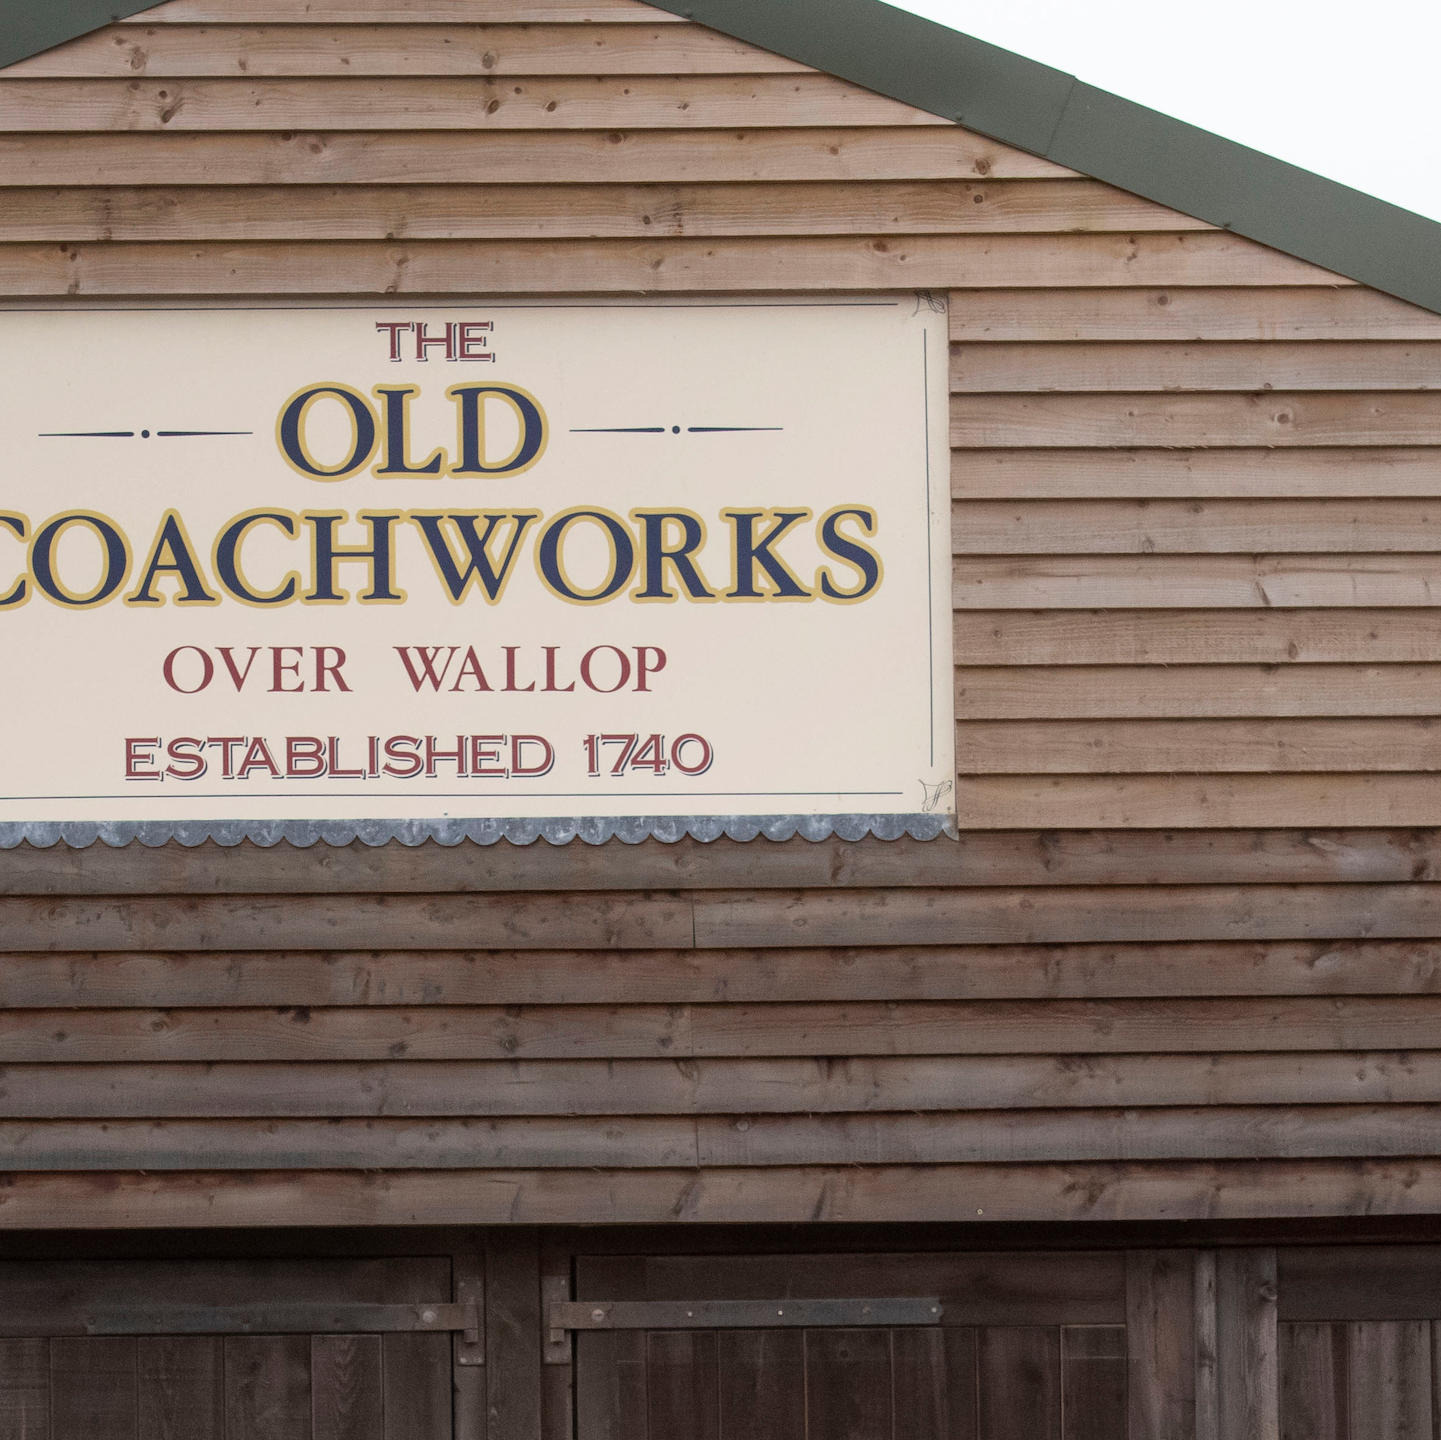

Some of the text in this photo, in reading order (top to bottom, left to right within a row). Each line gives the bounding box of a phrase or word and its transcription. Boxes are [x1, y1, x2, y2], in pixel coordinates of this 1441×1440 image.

[375, 321, 496, 364] THE
[276, 382, 549, 482] OLD
[163, 644, 668, 694] OVER WALLOP
[124, 732, 715, 782] ESTABLISHED 1740
